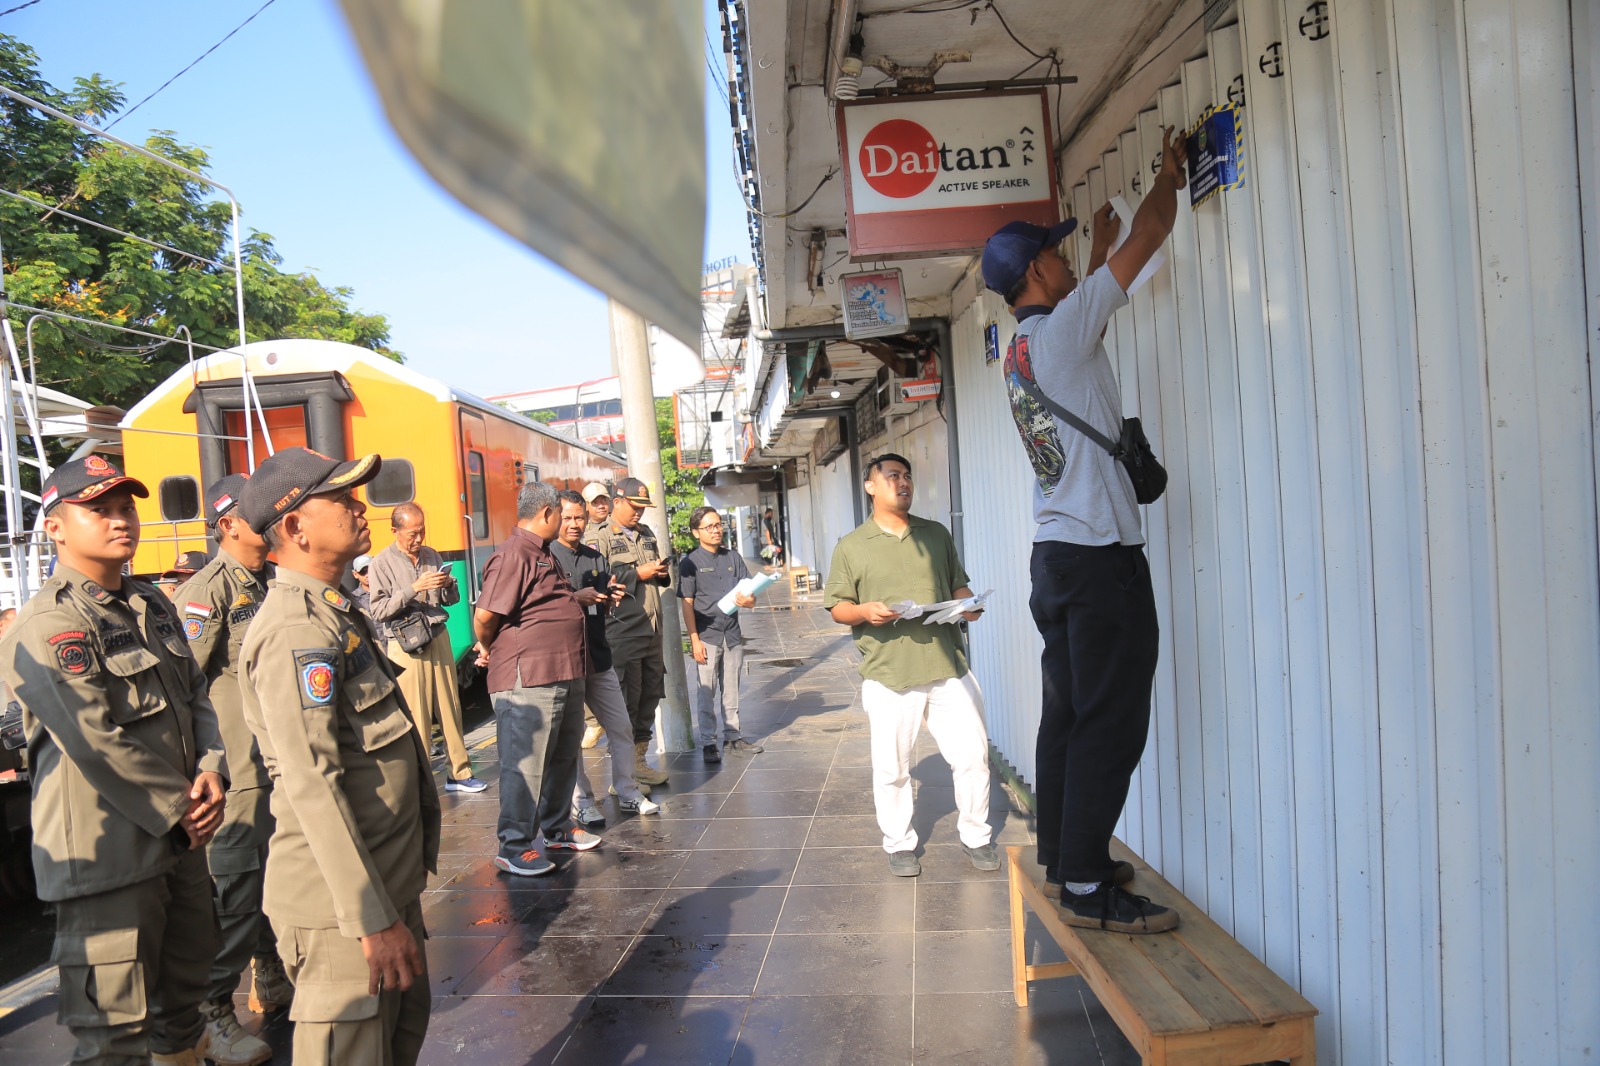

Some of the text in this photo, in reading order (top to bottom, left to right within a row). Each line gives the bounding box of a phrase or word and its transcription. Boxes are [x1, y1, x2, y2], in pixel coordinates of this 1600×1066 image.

[864, 141, 1011, 177] Daitan
[938, 178, 1031, 193] ACTIVE SPEAKER
[706, 254, 738, 274] HOTEL
[274, 487, 302, 511] HUT 70
